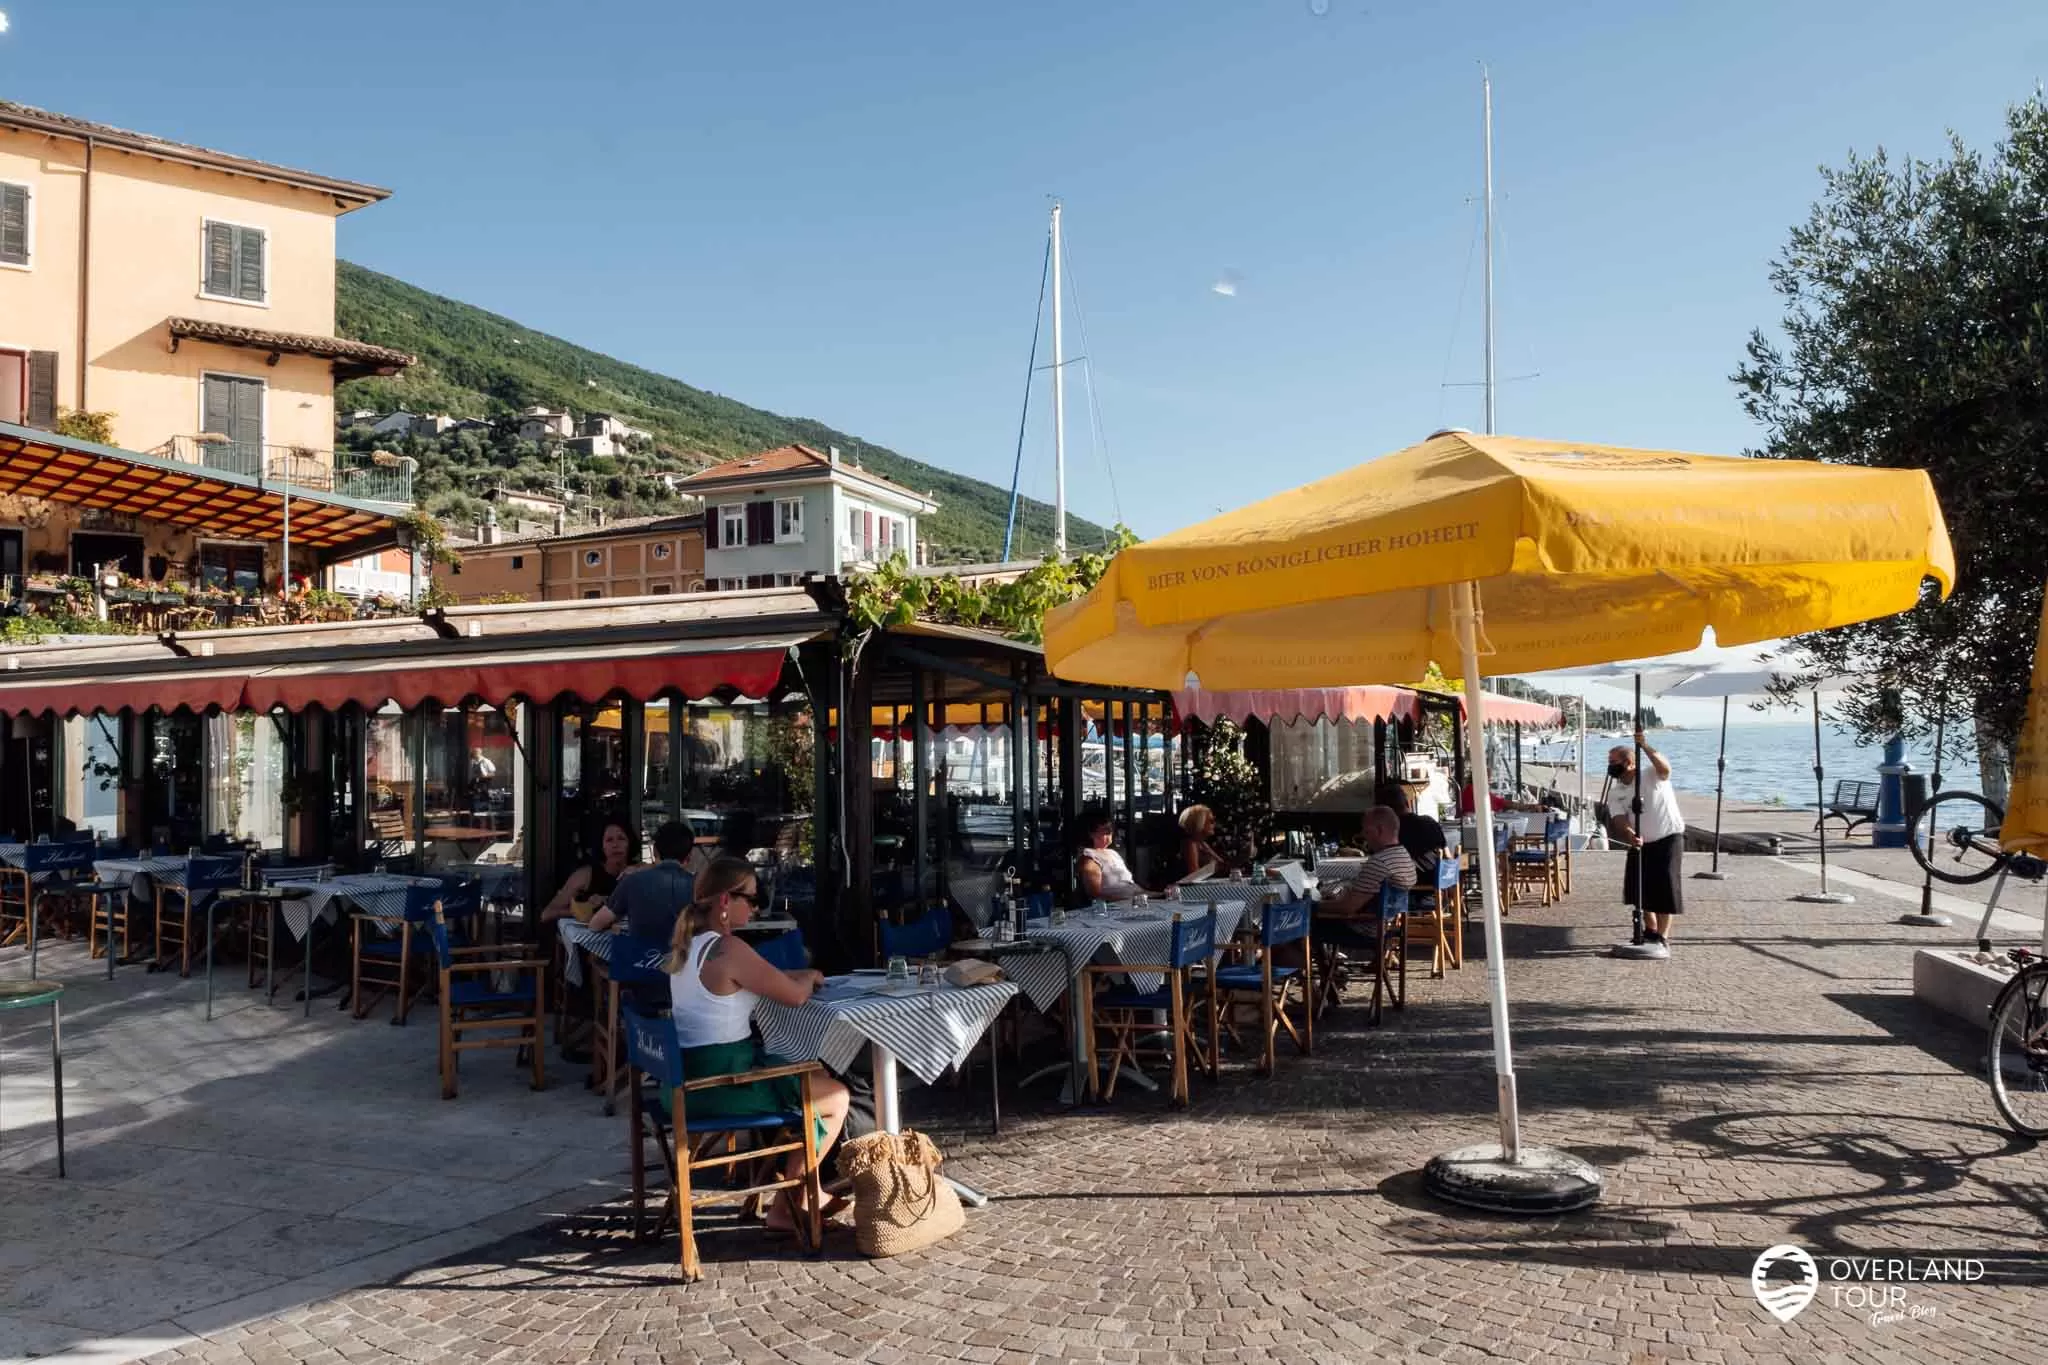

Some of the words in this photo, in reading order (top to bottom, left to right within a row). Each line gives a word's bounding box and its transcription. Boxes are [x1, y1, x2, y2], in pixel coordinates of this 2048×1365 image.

[1148, 571, 1185, 591] BIER
[1192, 563, 1230, 582] VON
[1236, 539, 1382, 576] KÖNIGLICHER
[1388, 521, 1480, 552] HOHEIT
